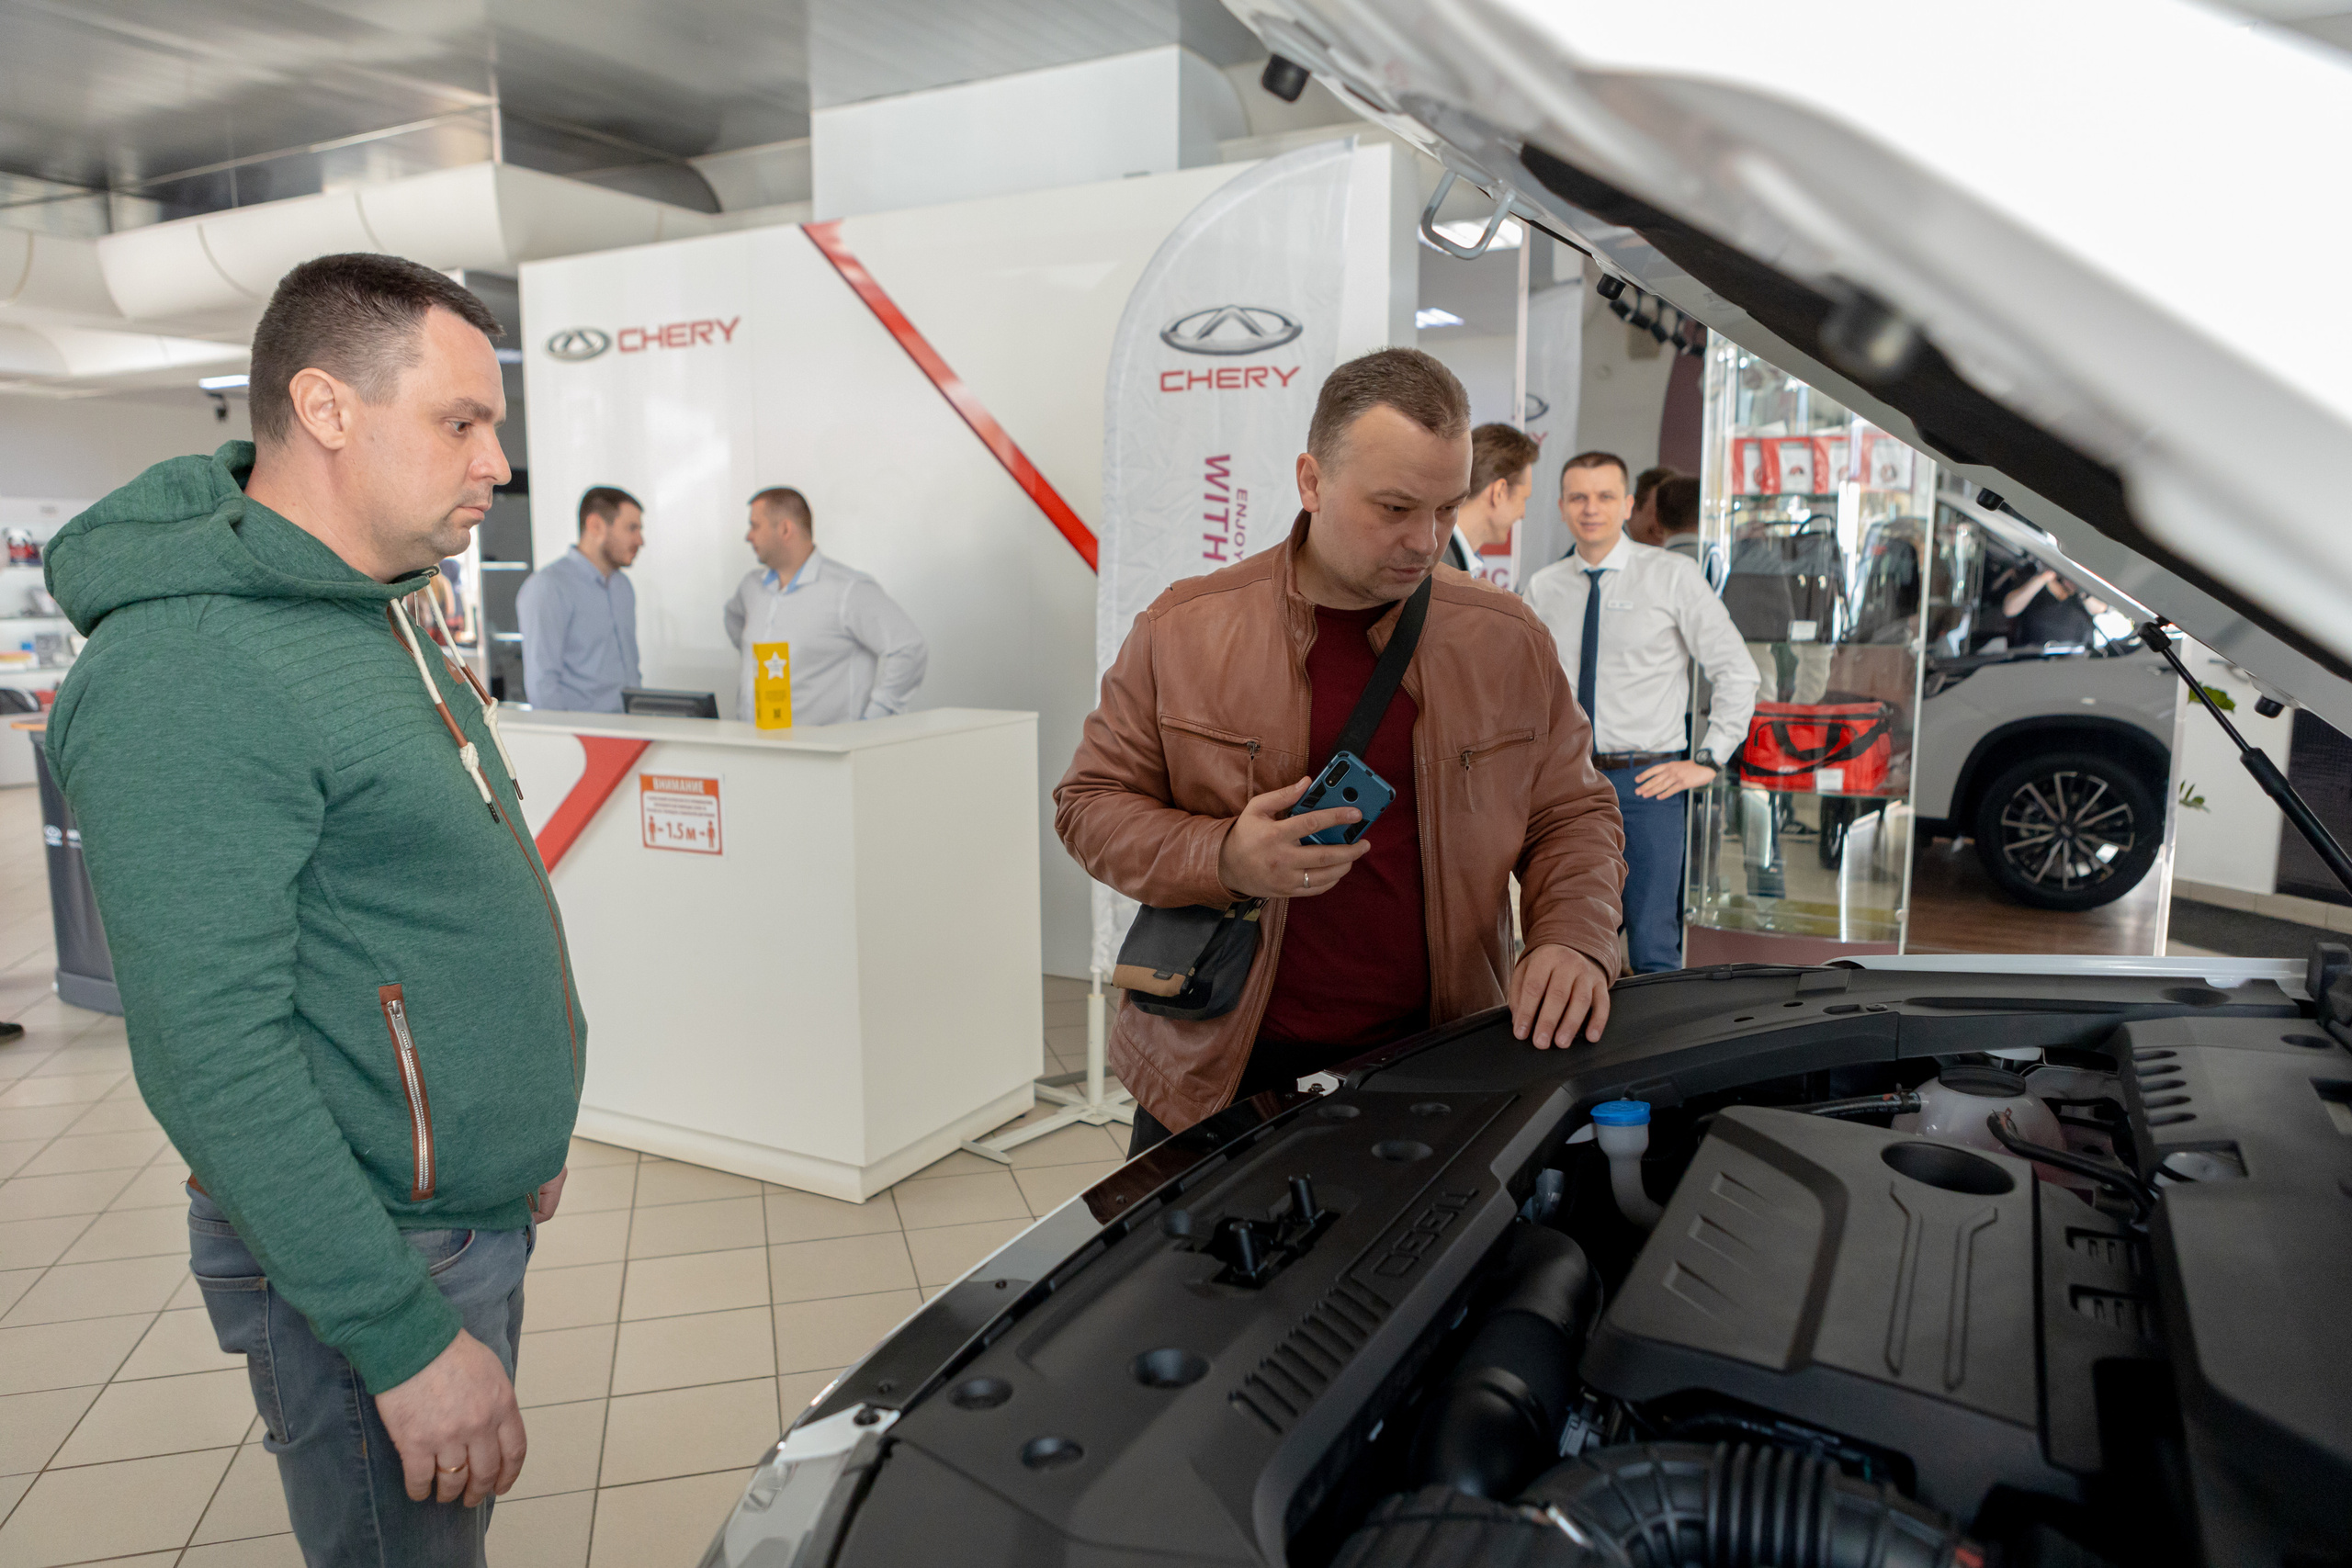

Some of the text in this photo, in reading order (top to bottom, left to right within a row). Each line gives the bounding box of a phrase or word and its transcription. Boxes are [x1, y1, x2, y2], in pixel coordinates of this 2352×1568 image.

[617, 316, 741, 353] CHERY
[1160, 367, 1301, 392] CHERY
[1203, 454, 1231, 562] WITH
[1234, 489, 1248, 560] ENJOY
